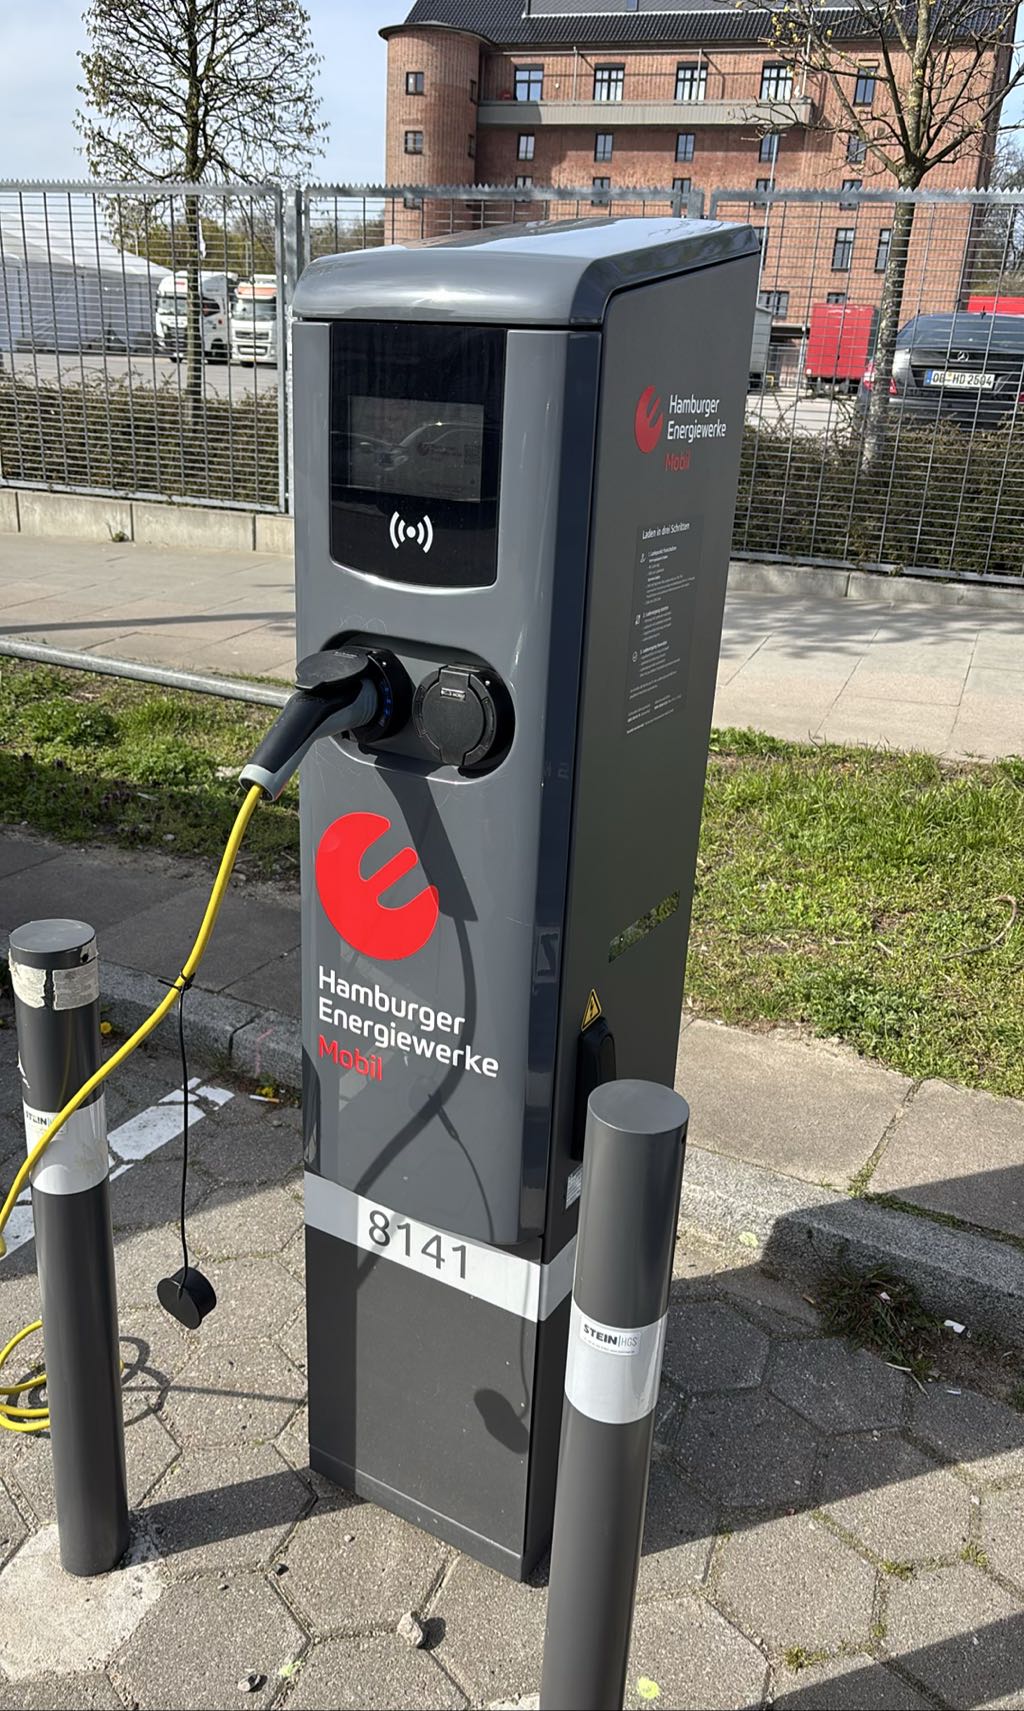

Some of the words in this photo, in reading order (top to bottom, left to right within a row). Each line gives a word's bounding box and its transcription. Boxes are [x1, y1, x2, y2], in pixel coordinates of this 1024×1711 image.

[952, 374, 966, 385] HD
[669, 394, 720, 417] Hamburger
[667, 419, 727, 443] Energiewerke
[665, 449, 691, 471] Mobil
[642, 528, 656, 540] Laden
[657, 526, 661, 536] in
[662, 525, 670, 535] drei
[671, 522, 690, 533] Schritten
[318, 965, 465, 1034] Hamburger
[318, 996, 499, 1078] Energiewerke
[318, 1034, 383, 1081] Mobil
[368, 1209, 467, 1280] 8141
